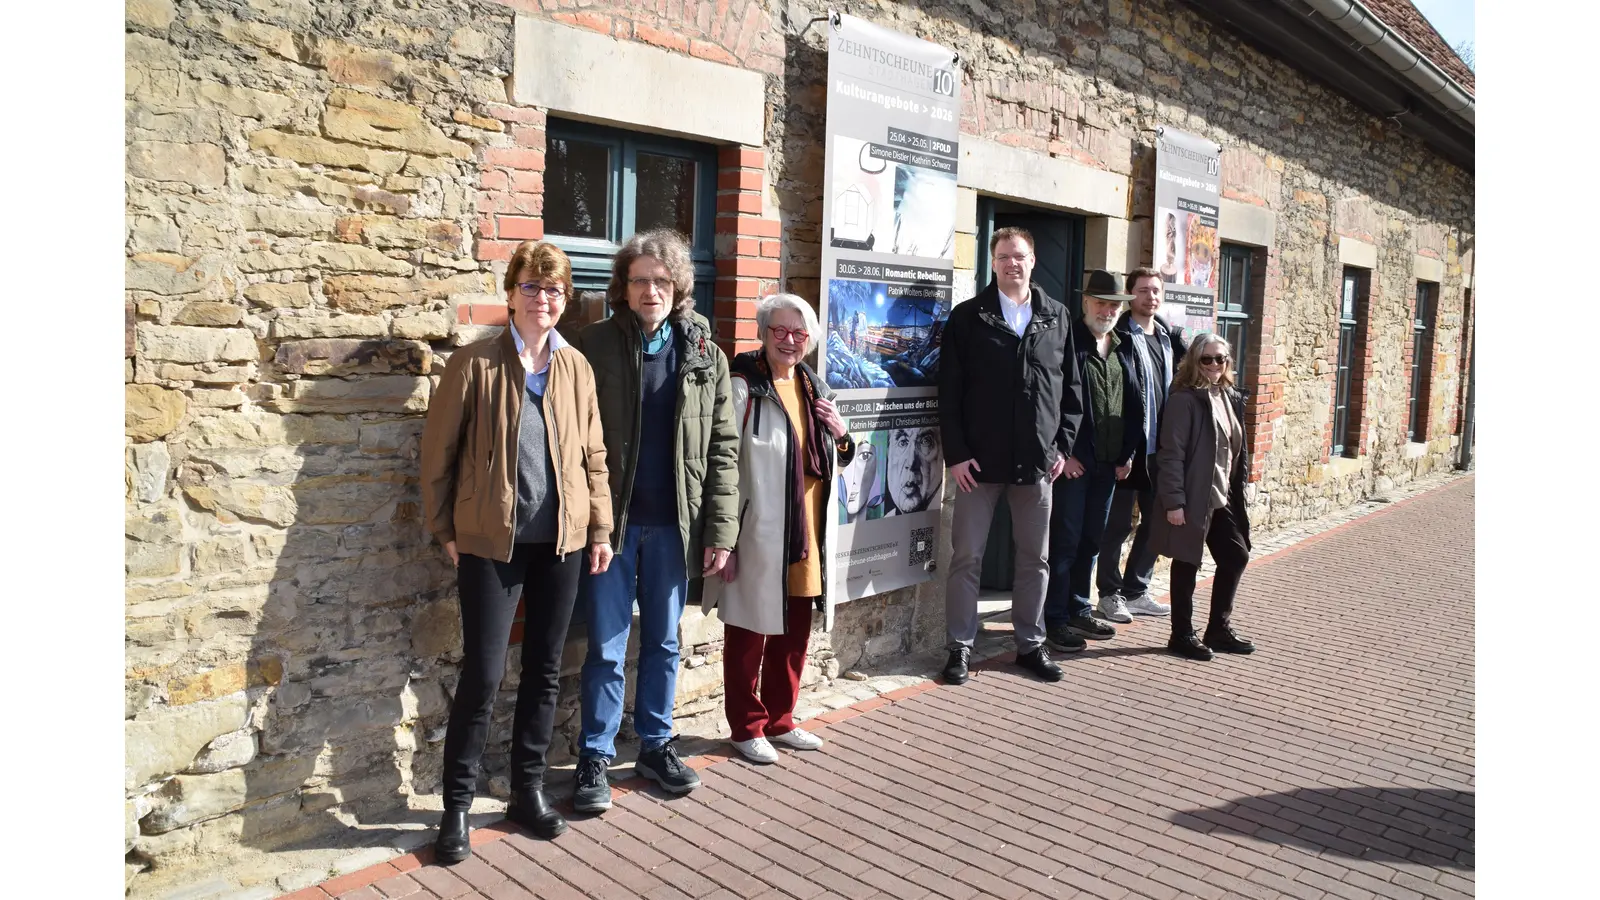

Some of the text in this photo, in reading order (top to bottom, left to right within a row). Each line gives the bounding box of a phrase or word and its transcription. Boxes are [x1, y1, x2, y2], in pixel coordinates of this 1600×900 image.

[837, 37, 953, 95] ZEHNTSCHEUNE 10
[836, 80, 920, 114] Kulturangebote
[931, 106, 953, 122] 2026
[890, 131, 907, 144] 25.04.
[912, 136, 929, 149] 25.05.
[932, 141, 952, 154] 2FOLD
[871, 146, 951, 171] Simone Distler Kathrin Schwarz
[1160, 141, 1217, 176] ZEHNTSCHEUNE 10
[1160, 169, 1200, 188] Kulturangebote
[1205, 183, 1217, 193] 2026
[838, 263, 857, 275] 30.05.
[863, 266, 881, 277] 28.06.
[885, 267, 916, 280] Romantic
[917, 269, 947, 282] Rebellion
[888, 286, 904, 295] Patrik
[904, 287, 923, 297] Wolters
[856, 403, 872, 413] 02.08.
[875, 401, 903, 412] Zwischen
[915, 400, 925, 409] der
[850, 420, 867, 430] Katrin
[867, 419, 890, 428] Hamann
[895, 416, 920, 427] Christiane
